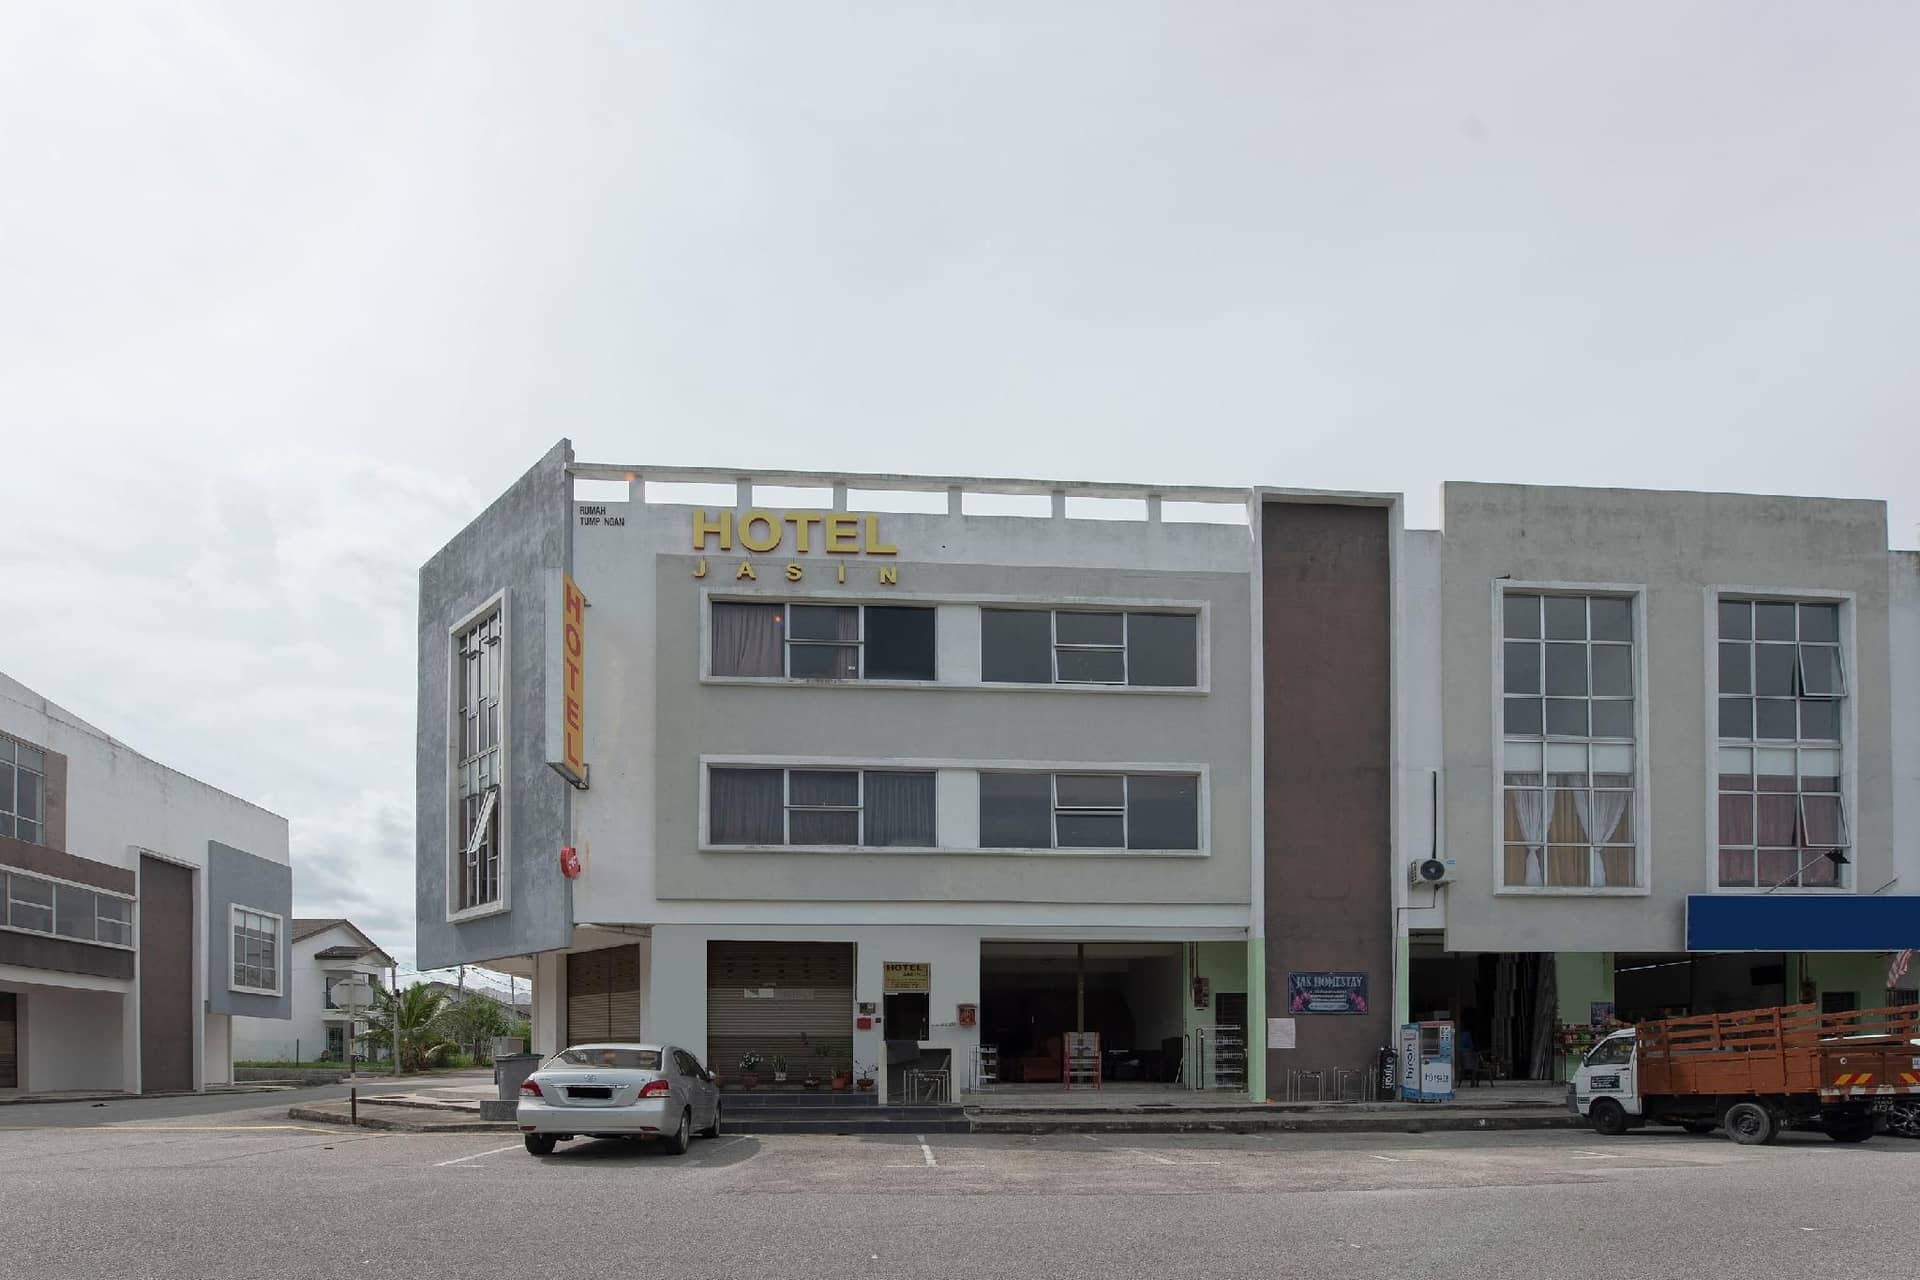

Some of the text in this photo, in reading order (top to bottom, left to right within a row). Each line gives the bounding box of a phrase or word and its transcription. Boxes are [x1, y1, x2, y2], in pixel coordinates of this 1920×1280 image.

[579, 505, 606, 515] RUMAH
[692, 509, 897, 555] HOTEL
[691, 558, 897, 585] JASIN
[565, 583, 581, 768] HOTEL
